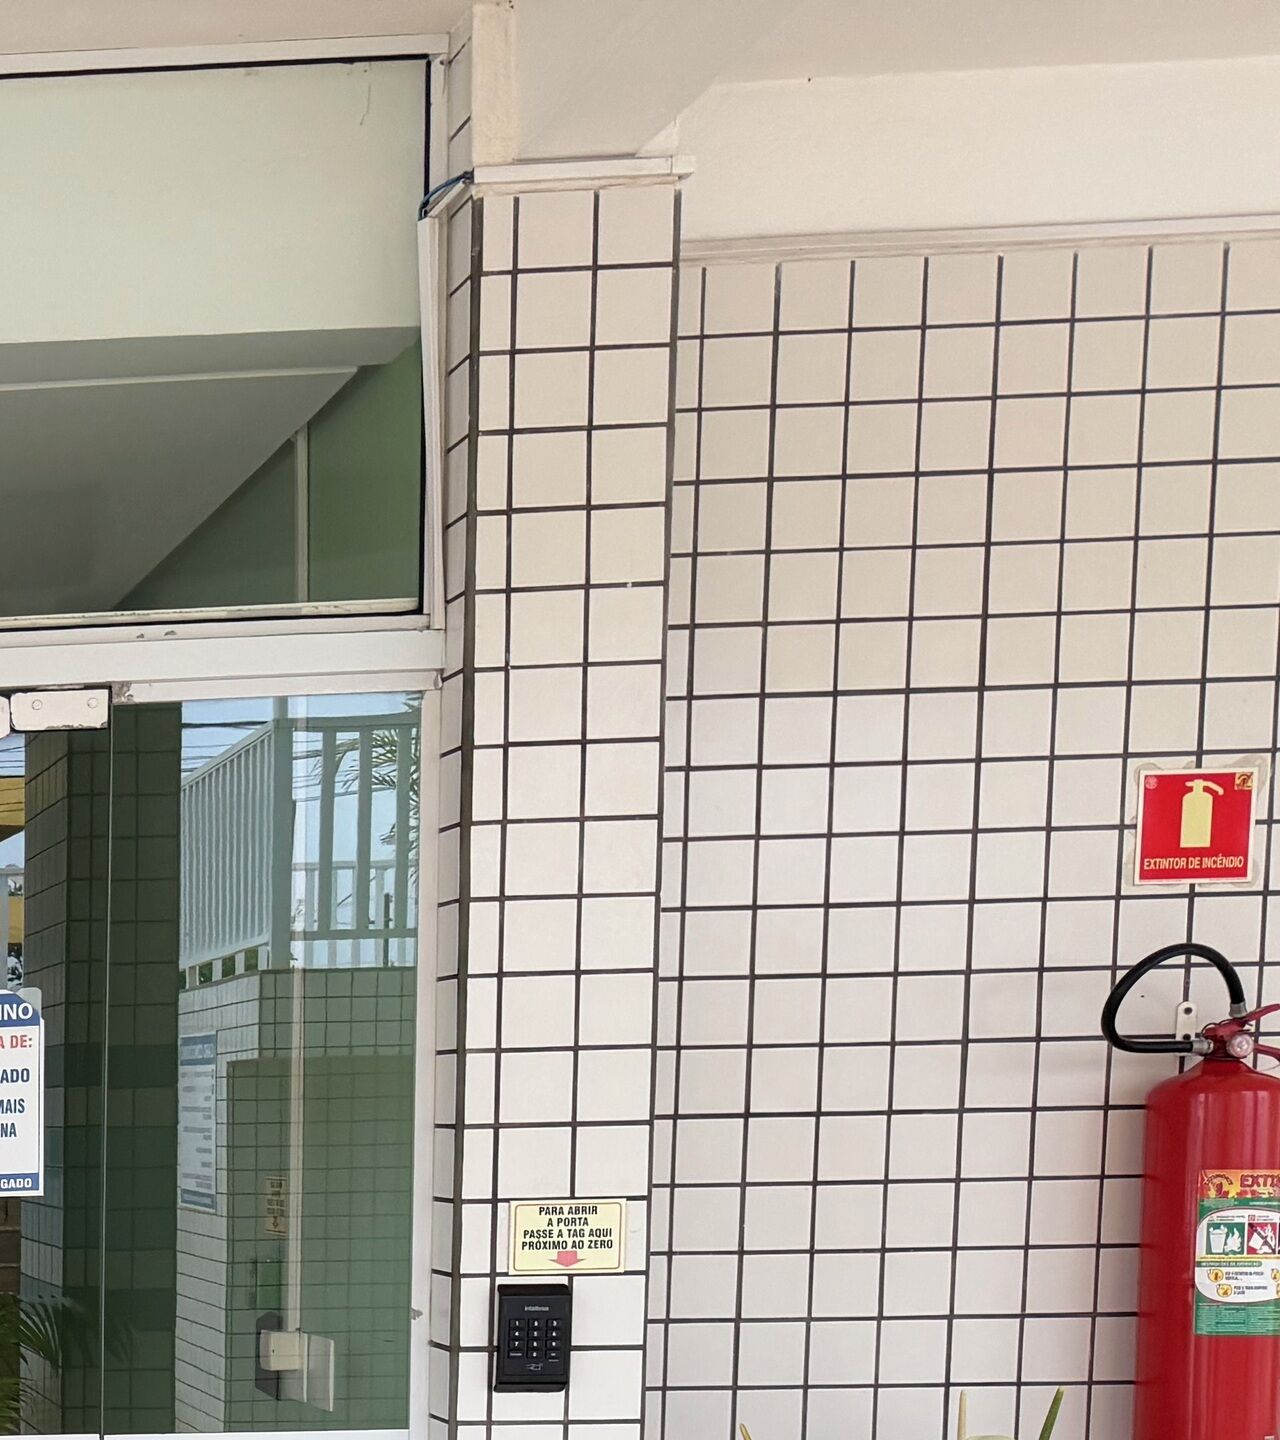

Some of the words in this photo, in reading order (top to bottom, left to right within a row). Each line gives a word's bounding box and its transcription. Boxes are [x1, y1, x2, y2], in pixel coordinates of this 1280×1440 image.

[1143, 856, 1186, 870] EXTINTOR
[1189, 856, 1200, 869] DE
[1202, 853, 1244, 869] INCÊNDIO
[10, 1034, 33, 1049] DE:
[0, 1122, 17, 1138] NA
[538, 1206, 565, 1216] PARA
[567, 1205, 598, 1215] ABRIR
[547, 1218, 553, 1227] A
[556, 1217, 589, 1227] PORTA
[523, 1229, 554, 1239] PASSE
[557, 1229, 563, 1238] A
[567, 1228, 585, 1238] TAG
[588, 1228, 612, 1238] AQUI
[521, 1239, 568, 1250] PRÓXIMO
[571, 1240, 584, 1249] AO
[587, 1239, 613, 1249] ZERO
